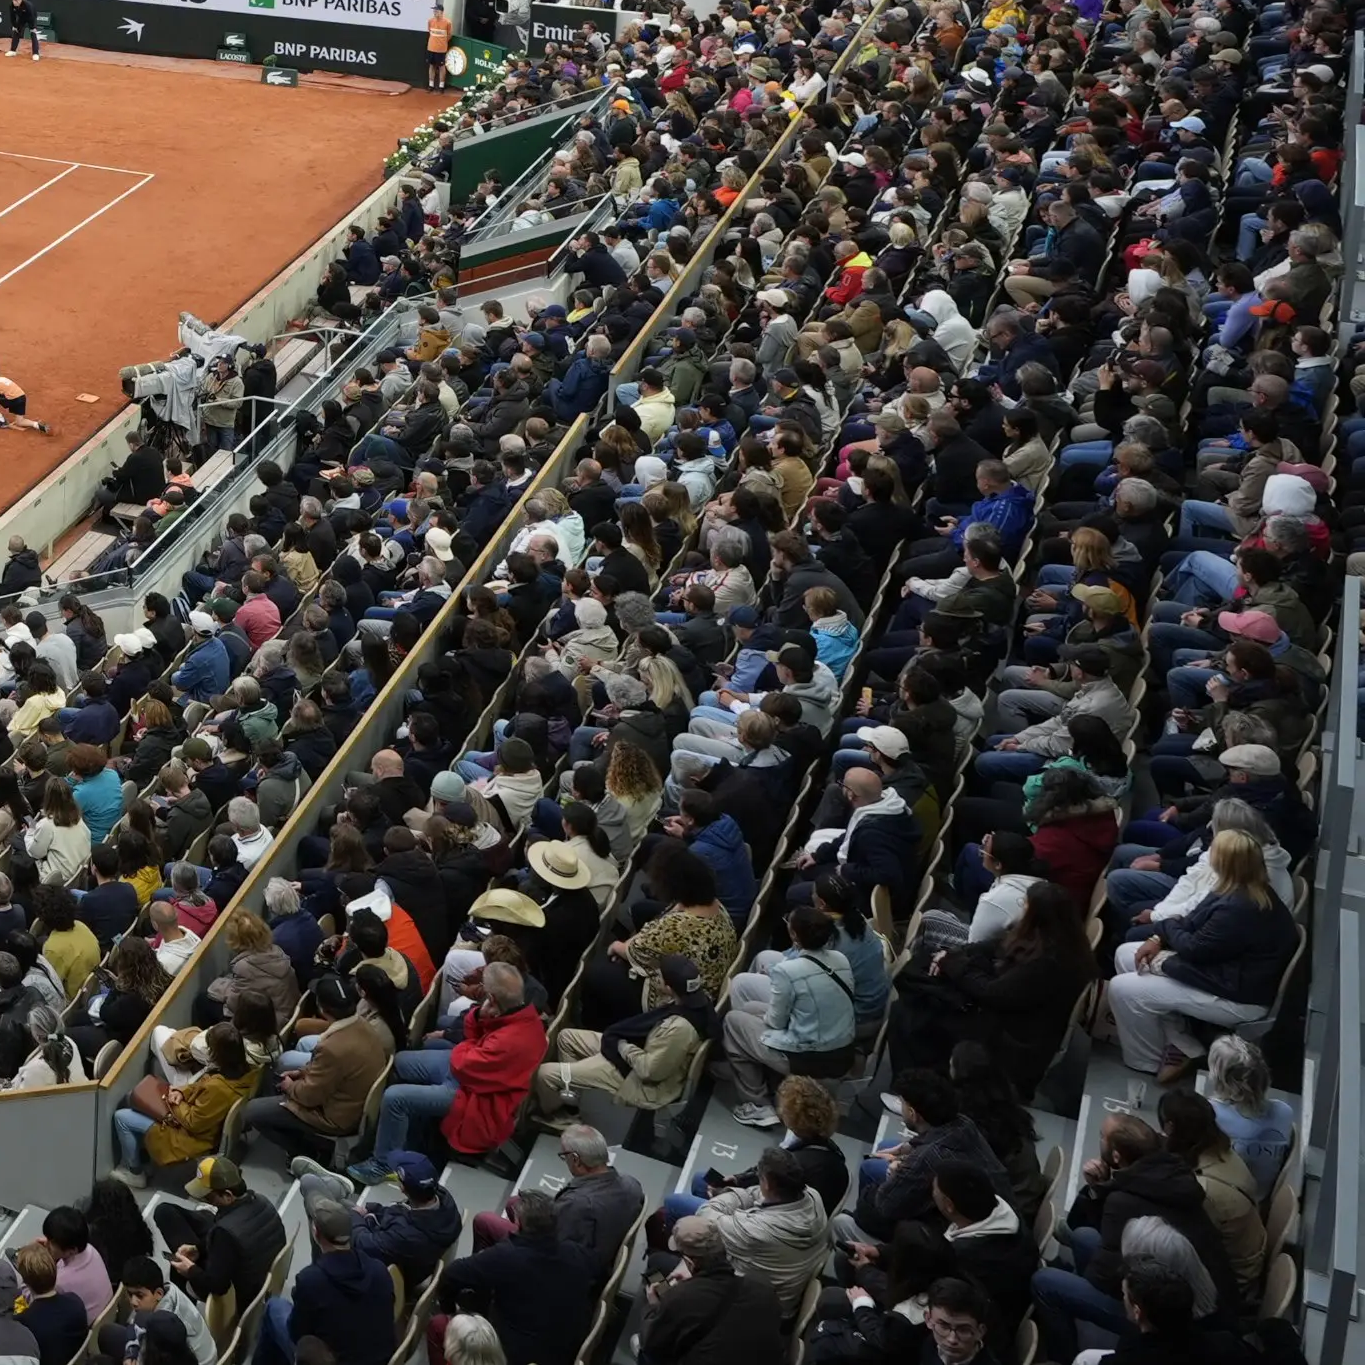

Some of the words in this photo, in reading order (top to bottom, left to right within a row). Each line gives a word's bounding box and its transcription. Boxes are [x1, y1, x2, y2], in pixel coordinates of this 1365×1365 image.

[532, 21, 611, 46] Emires
[219, 52, 247, 62] LACOSTE
[274, 42, 306, 57] BNP
[310, 44, 378, 65] PARIBAS
[711, 1140, 739, 1160] 13
[539, 1173, 566, 1191] 12
